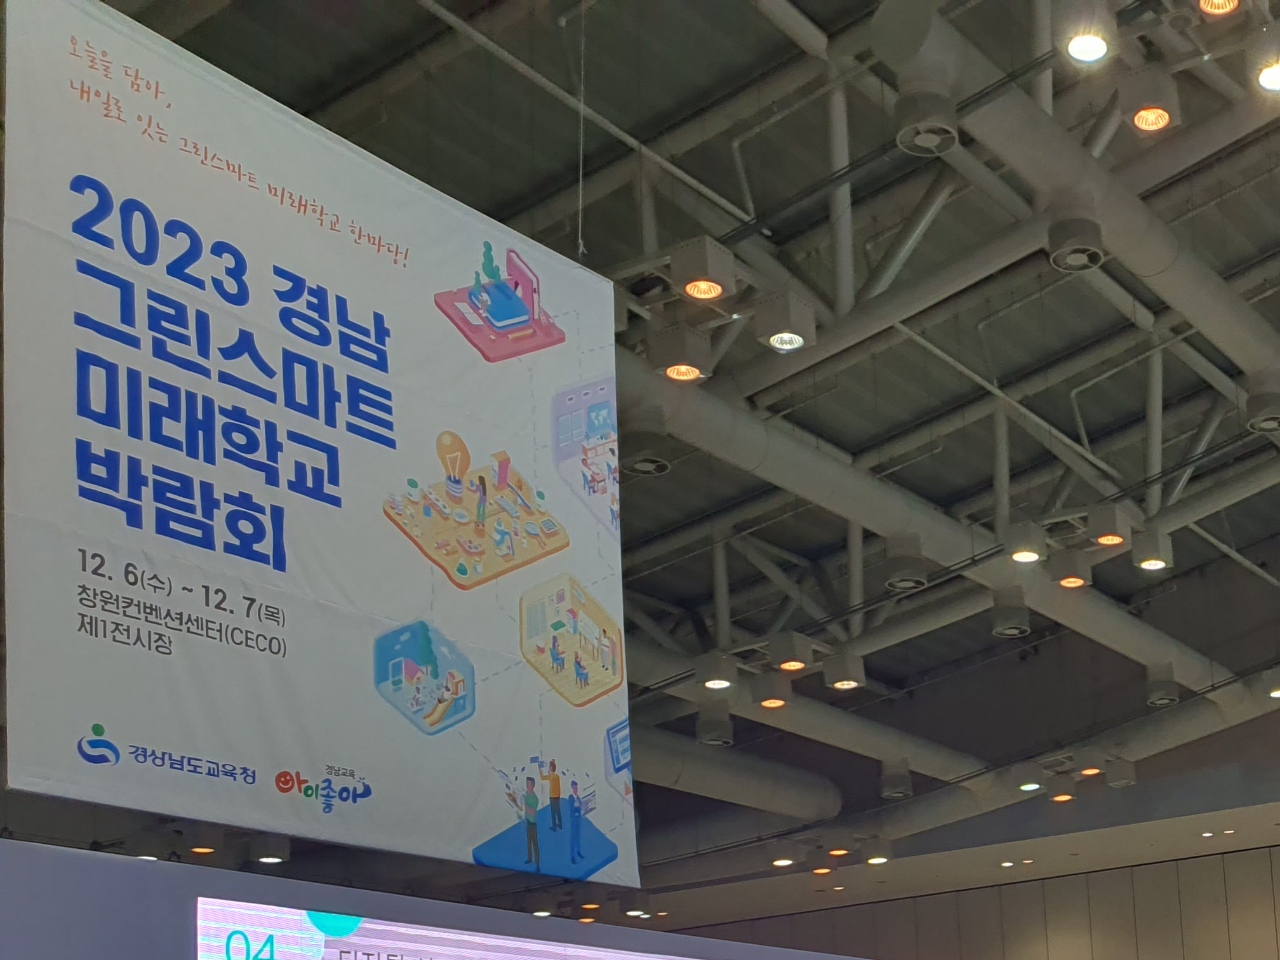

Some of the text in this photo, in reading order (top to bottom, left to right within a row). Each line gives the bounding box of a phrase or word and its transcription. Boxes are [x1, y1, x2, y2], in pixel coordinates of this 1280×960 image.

[69, 35, 172, 109] 오늘을 담아,
[70, 80, 409, 269] 내일로 잇는 그린스마트 미래학교 한마당!
[69, 174, 391, 374] 2023 경남
[73, 258, 397, 450] 그린스마트
[75, 347, 343, 509] 미래학교
[75, 437, 287, 574] 박람회
[77, 548, 286, 628] 12. 6(수) 12. 7(목)
[77, 583, 287, 658] 창원컨벤션센터(CECO)
[77, 612, 173, 656] 제1전시장
[128, 744, 257, 785] 경상남도교육청
[274, 769, 373, 814] 아이좋아
[325, 763, 357, 780] 경남교육
